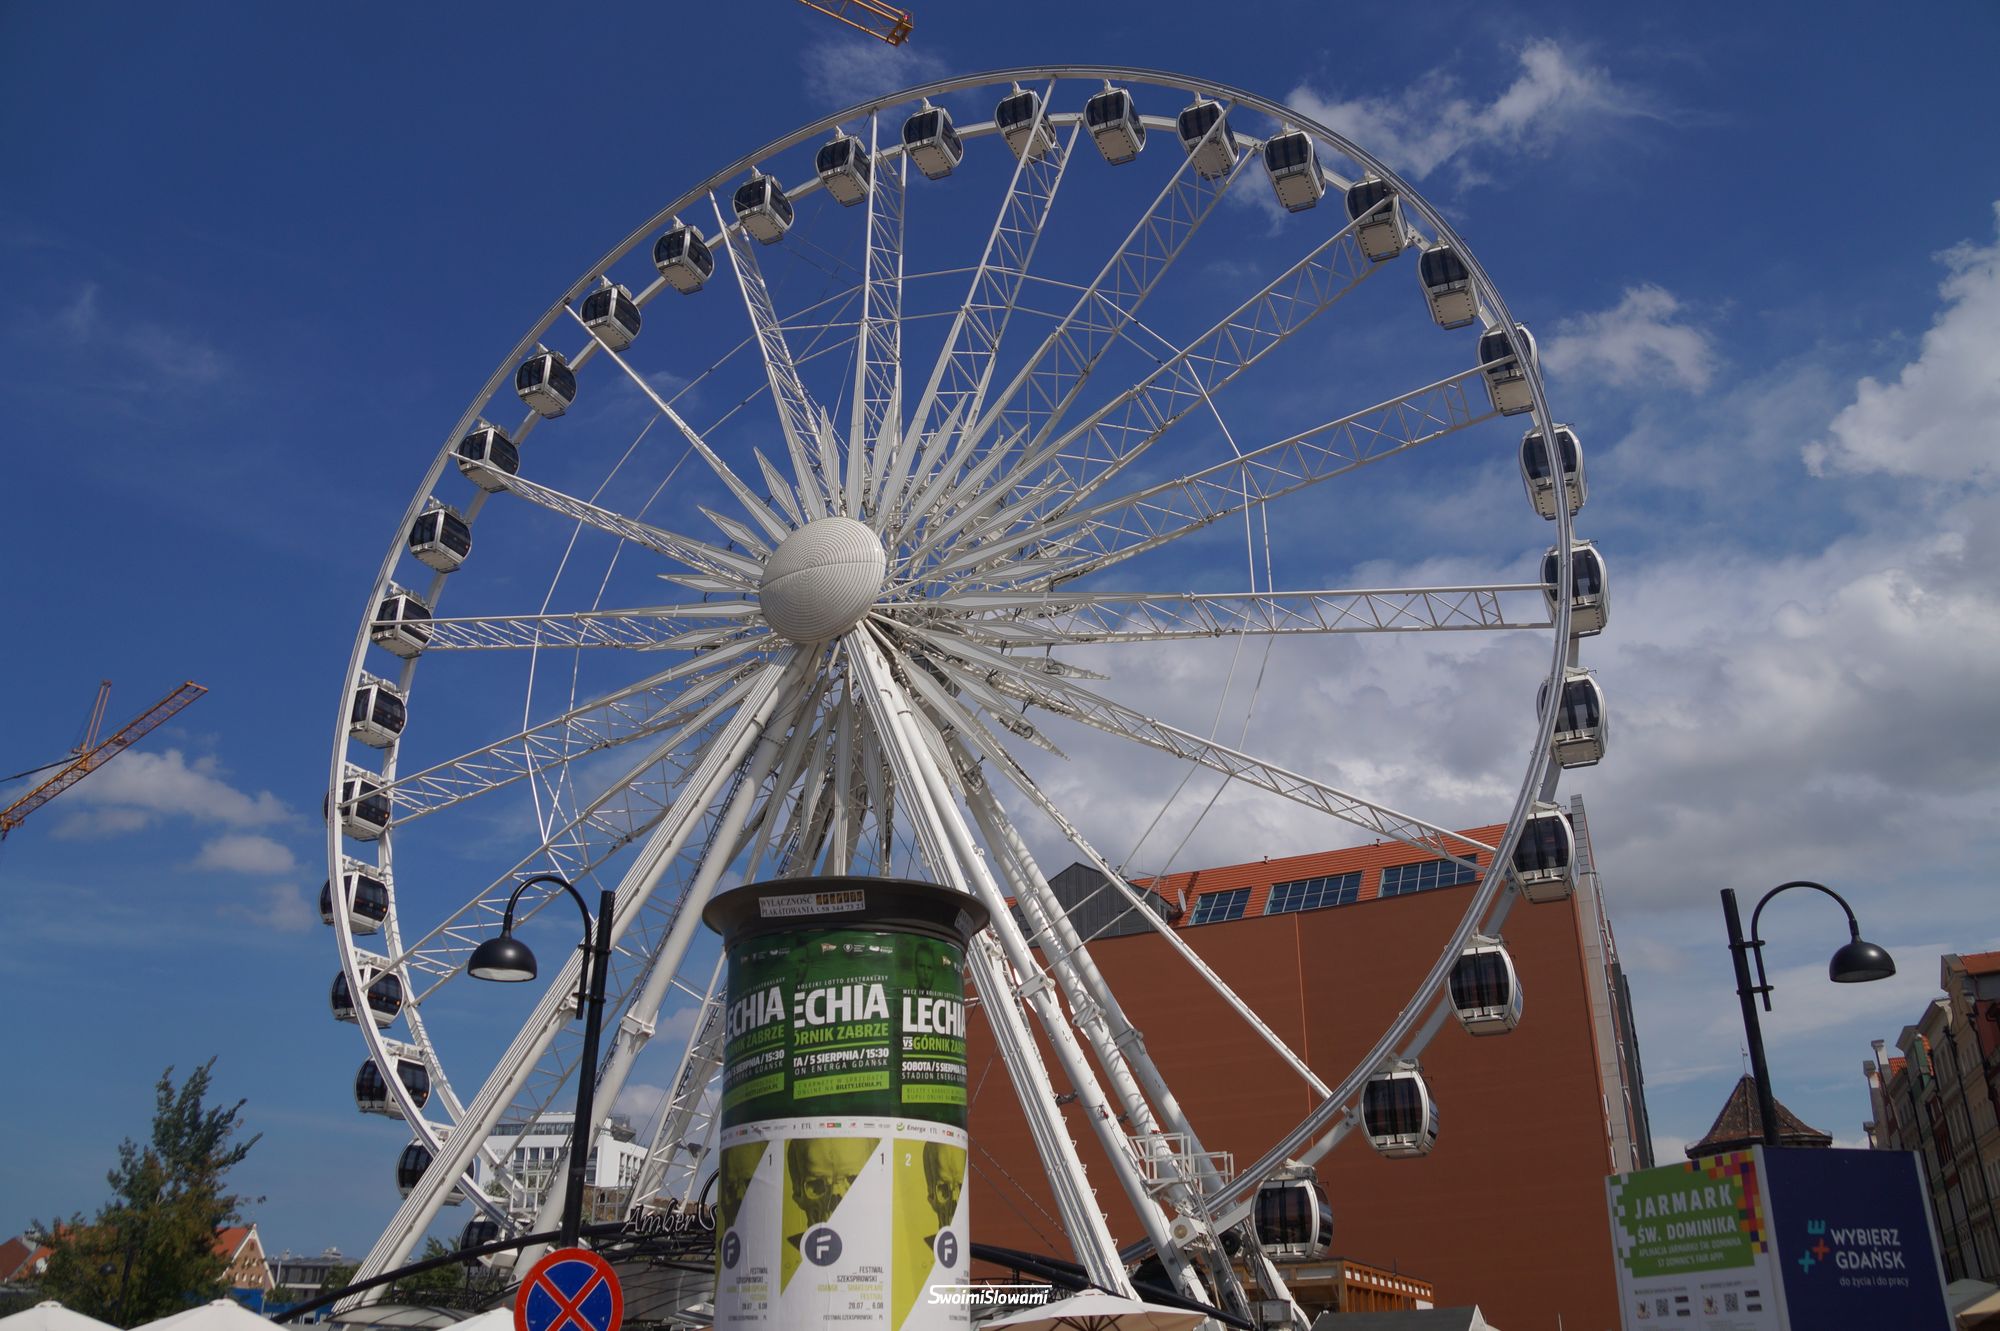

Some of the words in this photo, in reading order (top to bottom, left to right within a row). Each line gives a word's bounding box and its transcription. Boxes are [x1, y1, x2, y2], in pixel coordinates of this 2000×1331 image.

[761, 906, 815, 917] PLAKATOWANIA
[902, 996, 967, 1039] LECHIA
[837, 1023, 889, 1040] ZABRZE
[913, 1034, 950, 1052] GÓRNIK
[816, 1050, 860, 1064] SIERPNIA
[865, 1047, 890, 1058] 15:30
[811, 1062, 848, 1073] ENERGA
[902, 1061, 932, 1072] SOBOTA
[902, 1072, 934, 1080] STADION
[880, 1152, 885, 1165] 1
[905, 1153, 912, 1167] 2
[1635, 1184, 1733, 1220] JARMARK
[620, 1197, 696, 1233] Amber
[1637, 1223, 1662, 1244] ŚW.
[1666, 1215, 1738, 1241] DOMINIKA
[1830, 1228, 1901, 1246] WYBIERZ
[1835, 1246, 1906, 1269] GDAŃSK
[859, 1266, 884, 1274] FESTIWAL
[1839, 1276, 1851, 1286] do
[1852, 1276, 1872, 1288] życia
[1876, 1276, 1888, 1286] do
[1888, 1277, 1910, 1288] pracy
